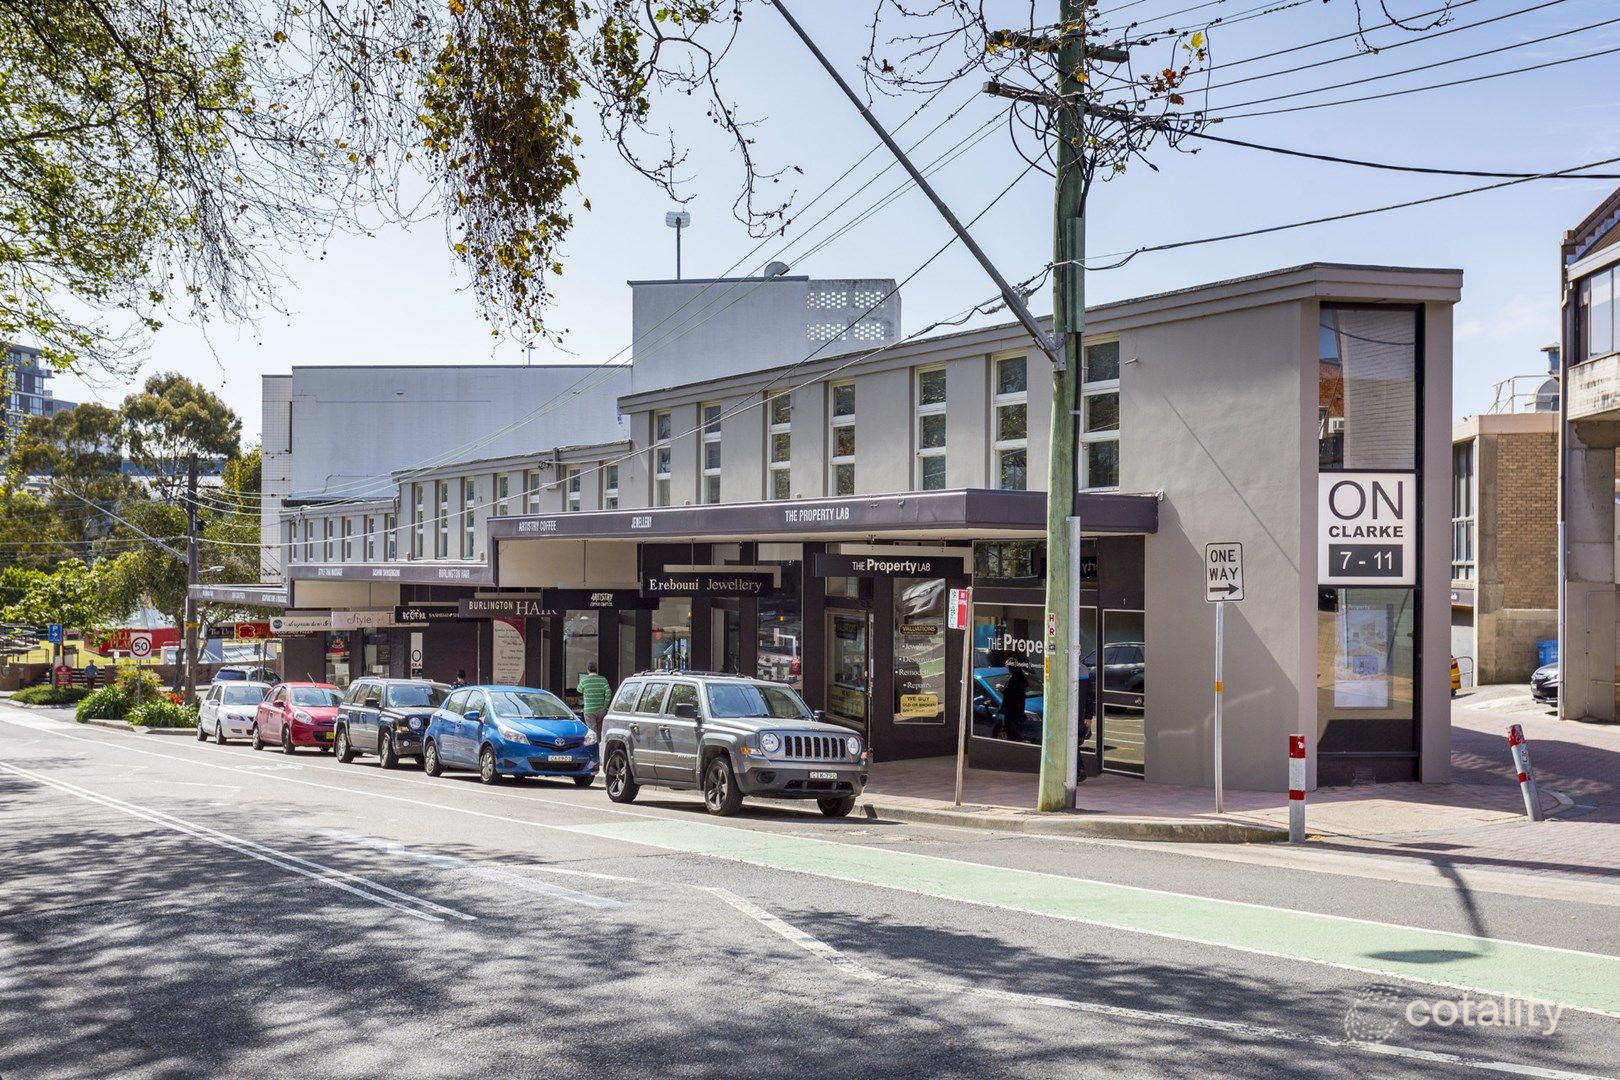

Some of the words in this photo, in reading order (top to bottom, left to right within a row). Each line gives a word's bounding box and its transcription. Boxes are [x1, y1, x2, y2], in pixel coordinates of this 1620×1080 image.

[1328, 480, 1404, 520] ON
[785, 510, 797, 521] THE
[799, 508, 834, 521] PROPERTY
[835, 507, 849, 519] LAB
[518, 521, 539, 532] ARTISTRY
[540, 520, 557, 531] COFFEE
[1328, 525, 1404, 538] CLARKE
[1210, 549, 1236, 563] ONE
[1340, 551, 1352, 570] 7
[1373, 551, 1392, 570] 11
[852, 561, 866, 571] THE
[866, 558, 917, 574] Property
[917, 562, 931, 572] LAB
[1209, 567, 1238, 581] WAY
[649, 578, 699, 591] Erebouni
[706, 579, 762, 593] Jewellery
[469, 600, 514, 610] BURLINGTON
[134, 642, 148, 651] 50
[987, 637, 1002, 651] THE
[1003, 633, 1044, 657] Prope
